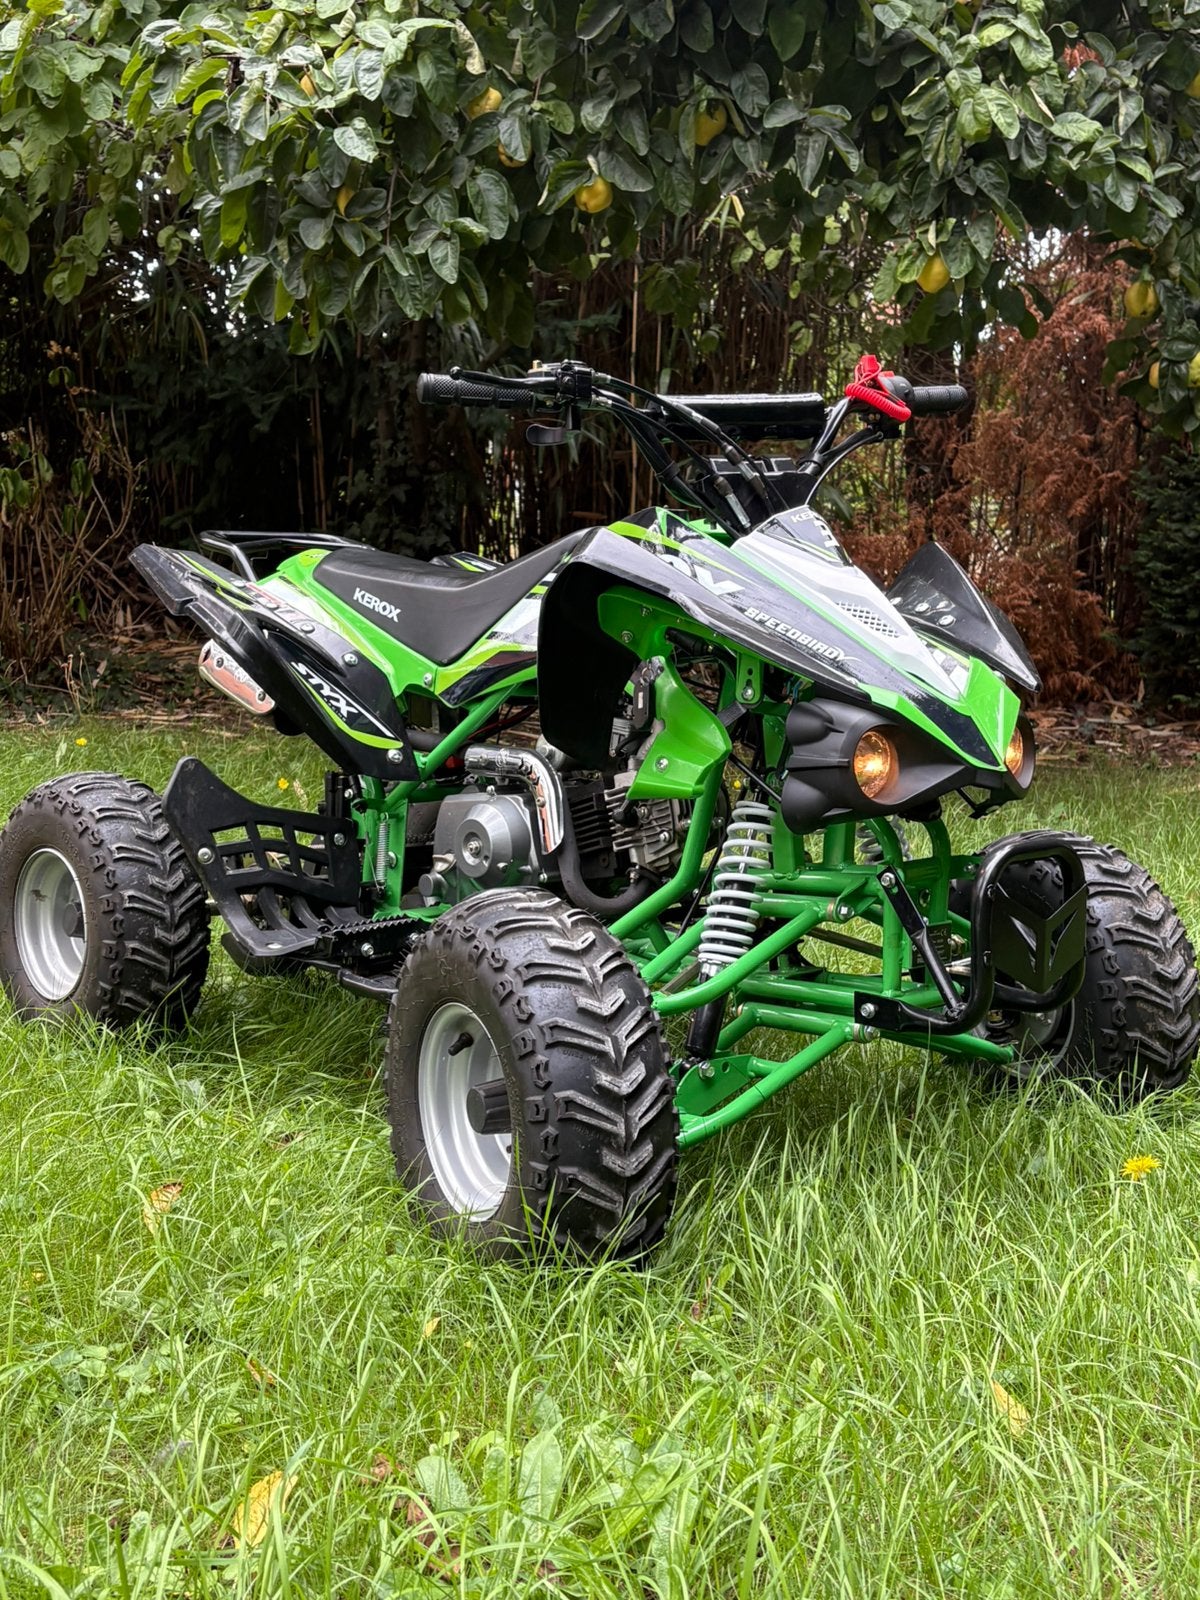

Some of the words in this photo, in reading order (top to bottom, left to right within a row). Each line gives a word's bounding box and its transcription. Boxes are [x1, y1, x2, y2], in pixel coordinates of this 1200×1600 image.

[353, 587, 401, 622] KEROX
[744, 606, 842, 662] SPEEDBIRD
[290, 661, 359, 718] STYX
